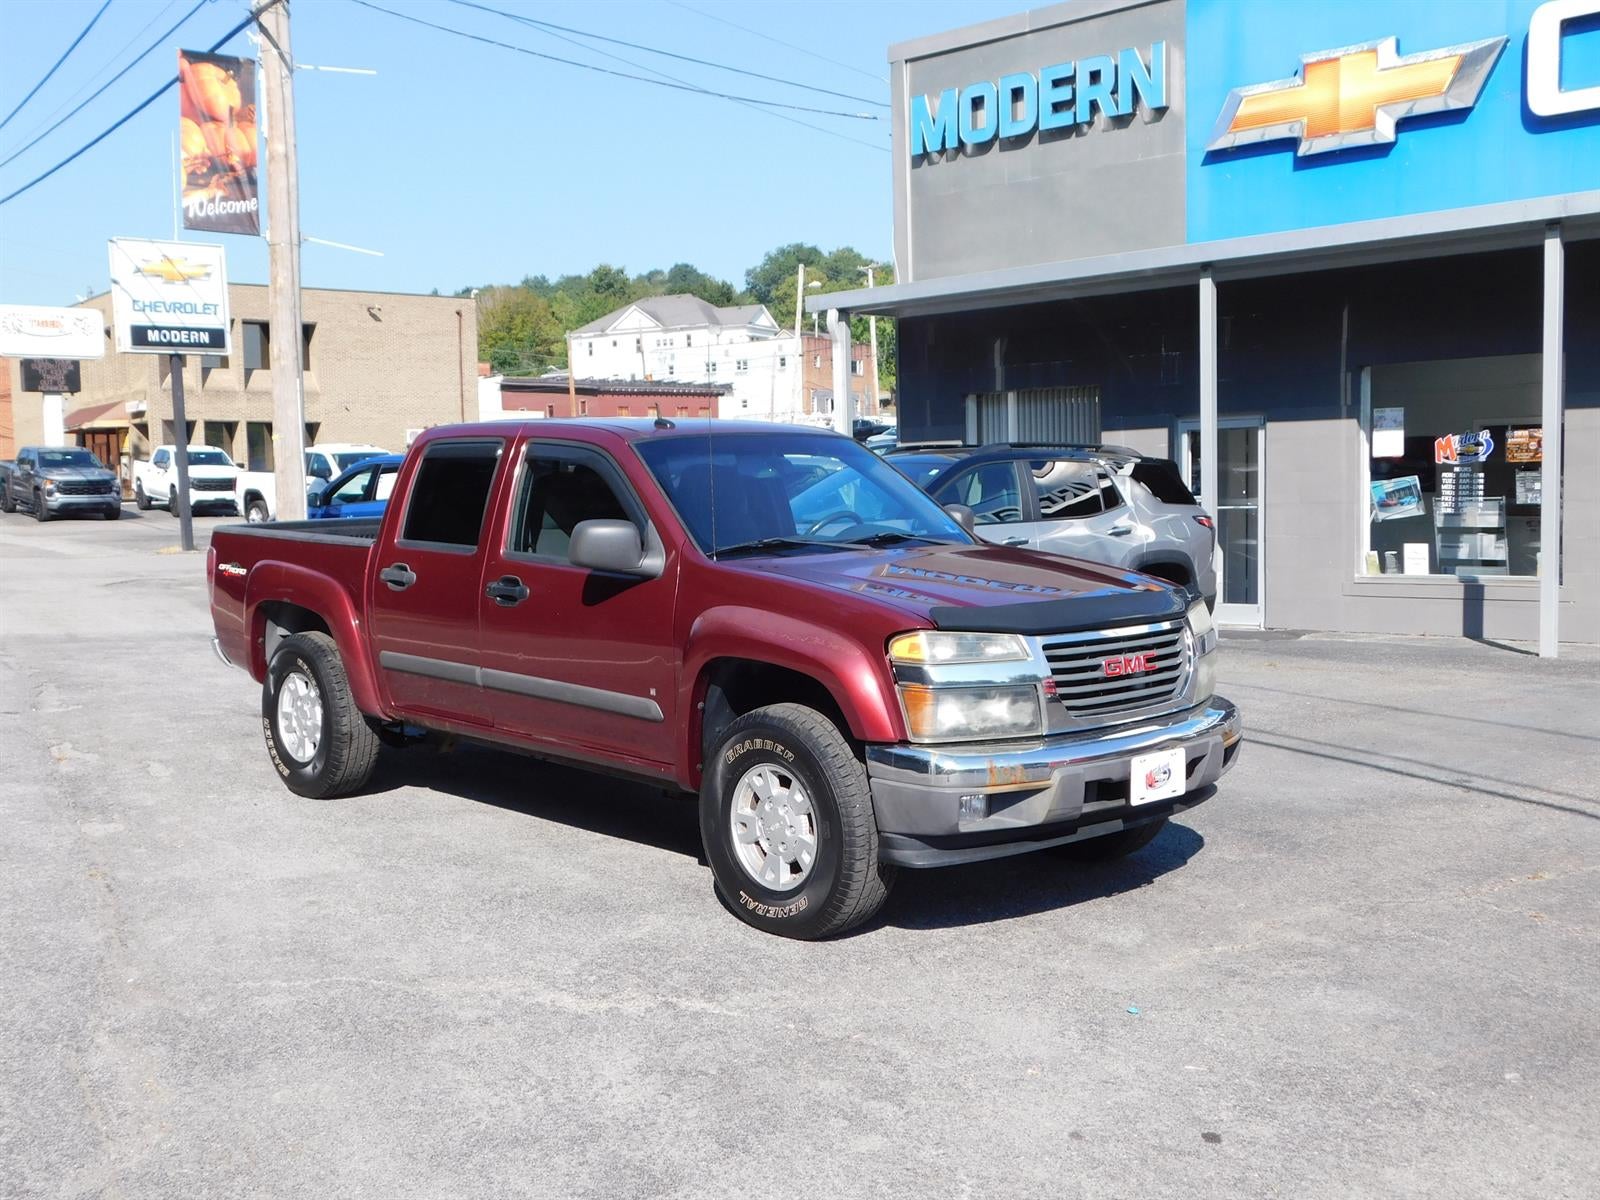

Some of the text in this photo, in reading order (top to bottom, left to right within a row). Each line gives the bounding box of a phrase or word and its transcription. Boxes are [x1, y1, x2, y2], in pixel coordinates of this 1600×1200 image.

[911, 40, 1168, 156] MODERN
[182, 191, 258, 218] Welcome
[133, 300, 219, 315] CHEVROLET
[147, 329, 210, 344] MODERN
[1103, 653, 1158, 678] GMC
[726, 738, 795, 764] GRABBER
[739, 890, 809, 918] GENERAL
